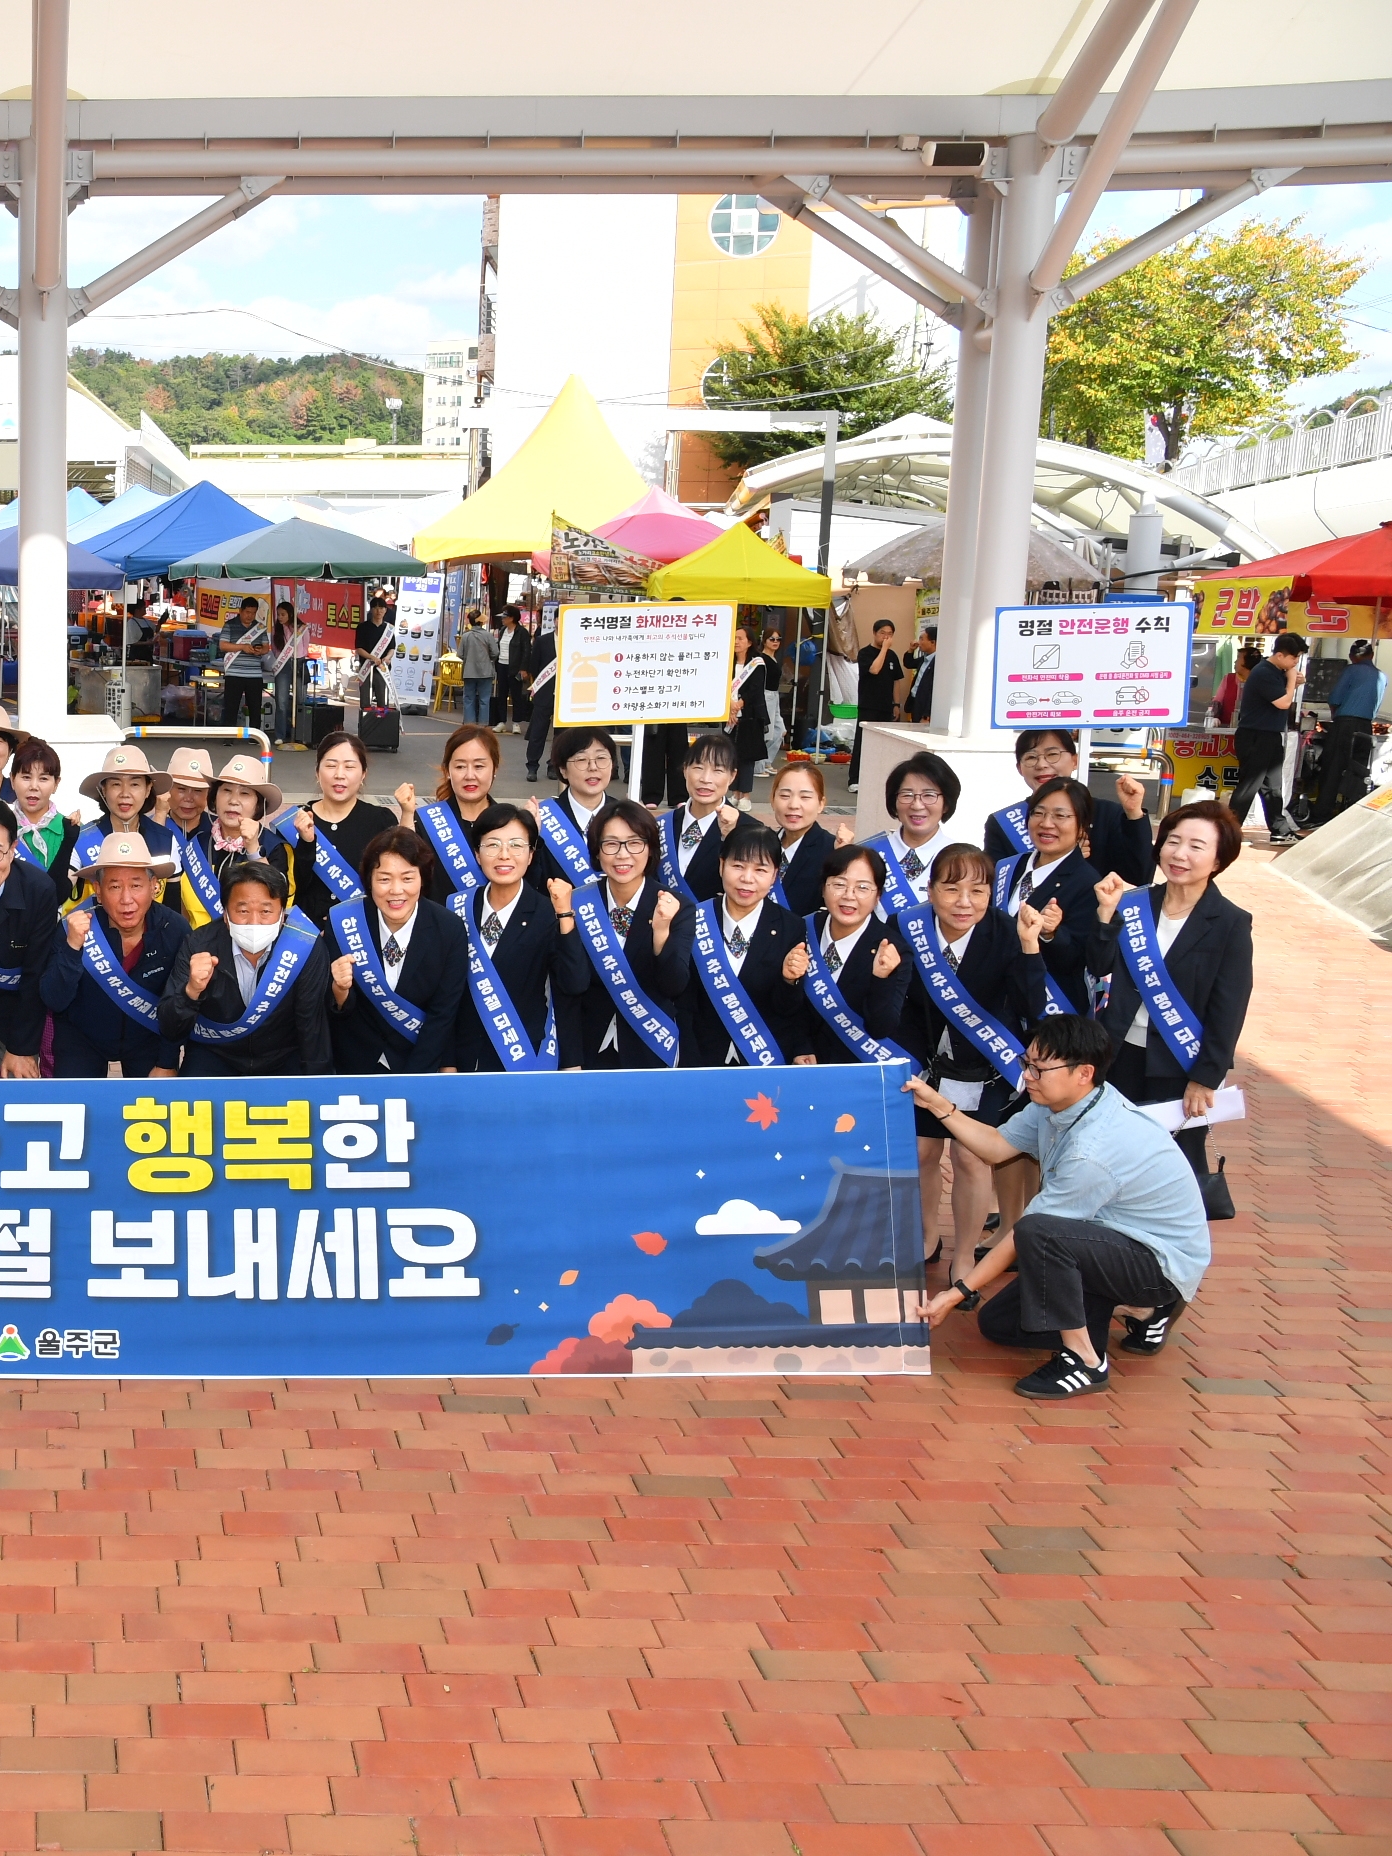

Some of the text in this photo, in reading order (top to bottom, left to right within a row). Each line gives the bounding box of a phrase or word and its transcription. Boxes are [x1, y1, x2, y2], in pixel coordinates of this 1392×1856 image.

[326, 602, 360, 629] 토스트
[579, 613, 717, 630] 추석명절 화재안전 수칙
[1018, 615, 1171, 637] 명절 안전운행 수칙
[1211, 586, 1261, 628] 군밤
[625, 652, 657, 663] 사용하지
[659, 652, 675, 662] 않는
[678, 652, 701, 661] 플러그
[703, 651, 719, 660] 뽑기
[625, 669, 664, 679] 누전차단기
[667, 667, 697, 677] 확인하기
[623, 701, 669, 711] 차량용소화기
[671, 701, 687, 709] 비치
[690, 700, 705, 709] 하기
[624, 685, 655, 695] 가스밸브
[426, 806, 468, 871] 안전한 추석
[539, 804, 590, 872] 안전한 추석
[327, 865, 354, 891] 추석
[265, 950, 299, 998] 안전한
[341, 916, 369, 967] 안전한
[362, 969, 387, 997] 추석
[578, 904, 677, 1052] 안전한 추석 명절 되세요
[1122, 905, 1181, 1026] 안전한 추석 명절
[246, 1000, 270, 1025] 추석
[706, 957, 731, 989] 추석
[721, 992, 748, 1024] 명절
[739, 1022, 776, 1067] 되세요
[812, 978, 838, 1011] 추석
[833, 1011, 865, 1042] 명절
[908, 918, 1018, 1066] 안전한 추석 명절 되세요
[476, 977, 502, 1012] 명절
[492, 1012, 526, 1062] 되세요
[121, 1095, 416, 1195] 행복한
[85, 1207, 483, 1301] 보내세요
[36, 1328, 120, 1358] 울주군
